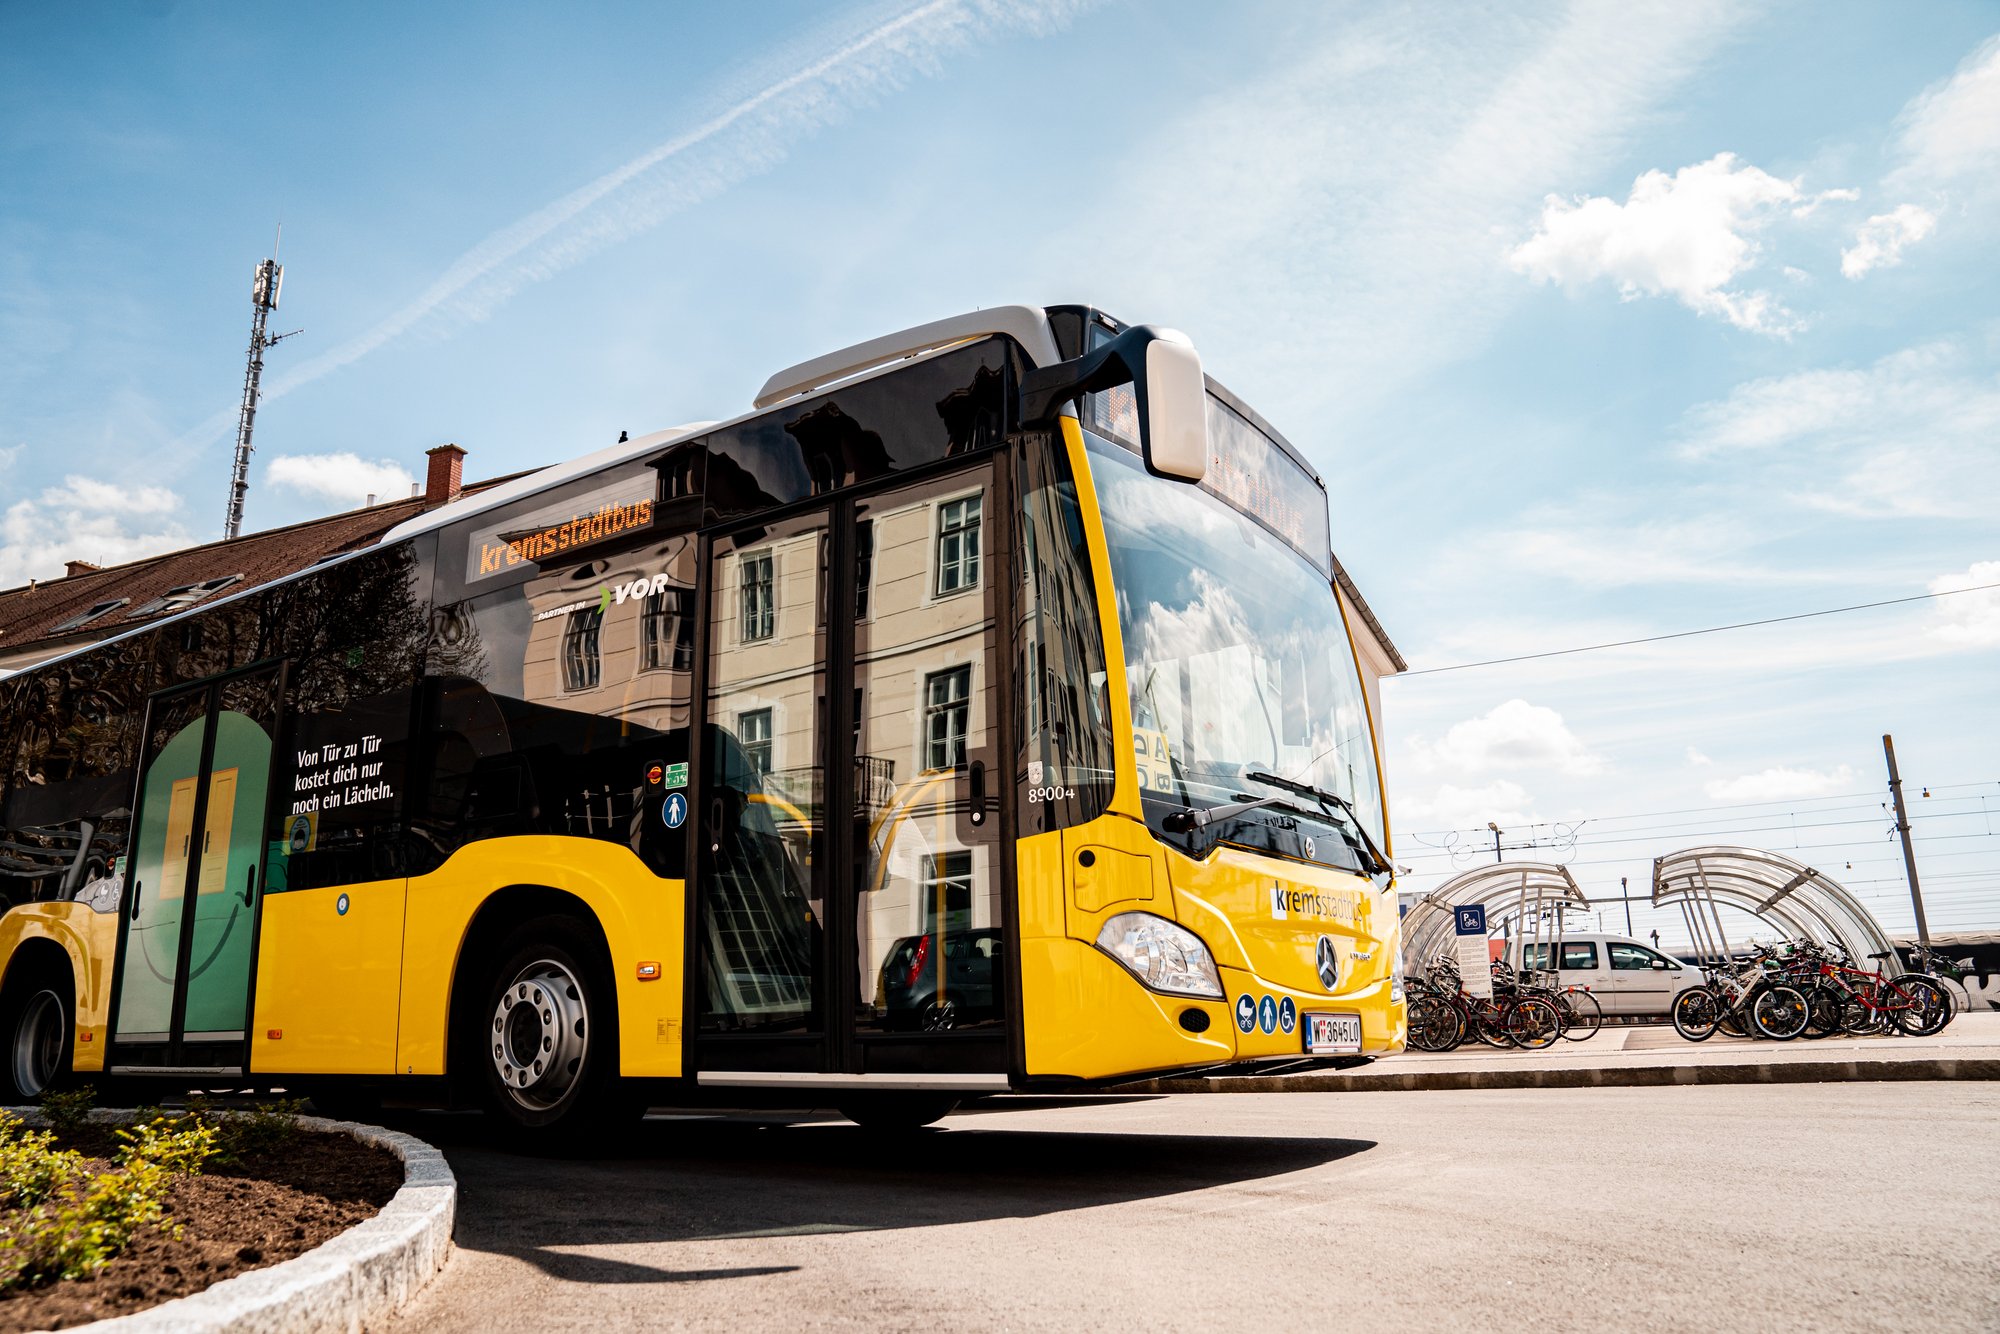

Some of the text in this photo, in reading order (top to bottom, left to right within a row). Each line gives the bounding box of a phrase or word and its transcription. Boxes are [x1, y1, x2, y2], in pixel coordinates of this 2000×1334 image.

[537, 573, 669, 621] PARTNER IM VOR
[297, 735, 382, 768] Von Tür zu Tür
[1155, 736, 1167, 760] A
[294, 762, 383, 791] kostet dich nur
[292, 781, 394, 815] noch ein Lächeln.
[1028, 785, 1075, 804] 89004
[1275, 880, 1362, 922] kremsstadtbus
[1463, 913, 1469, 922] P
[1313, 1020, 1320, 1043] W
